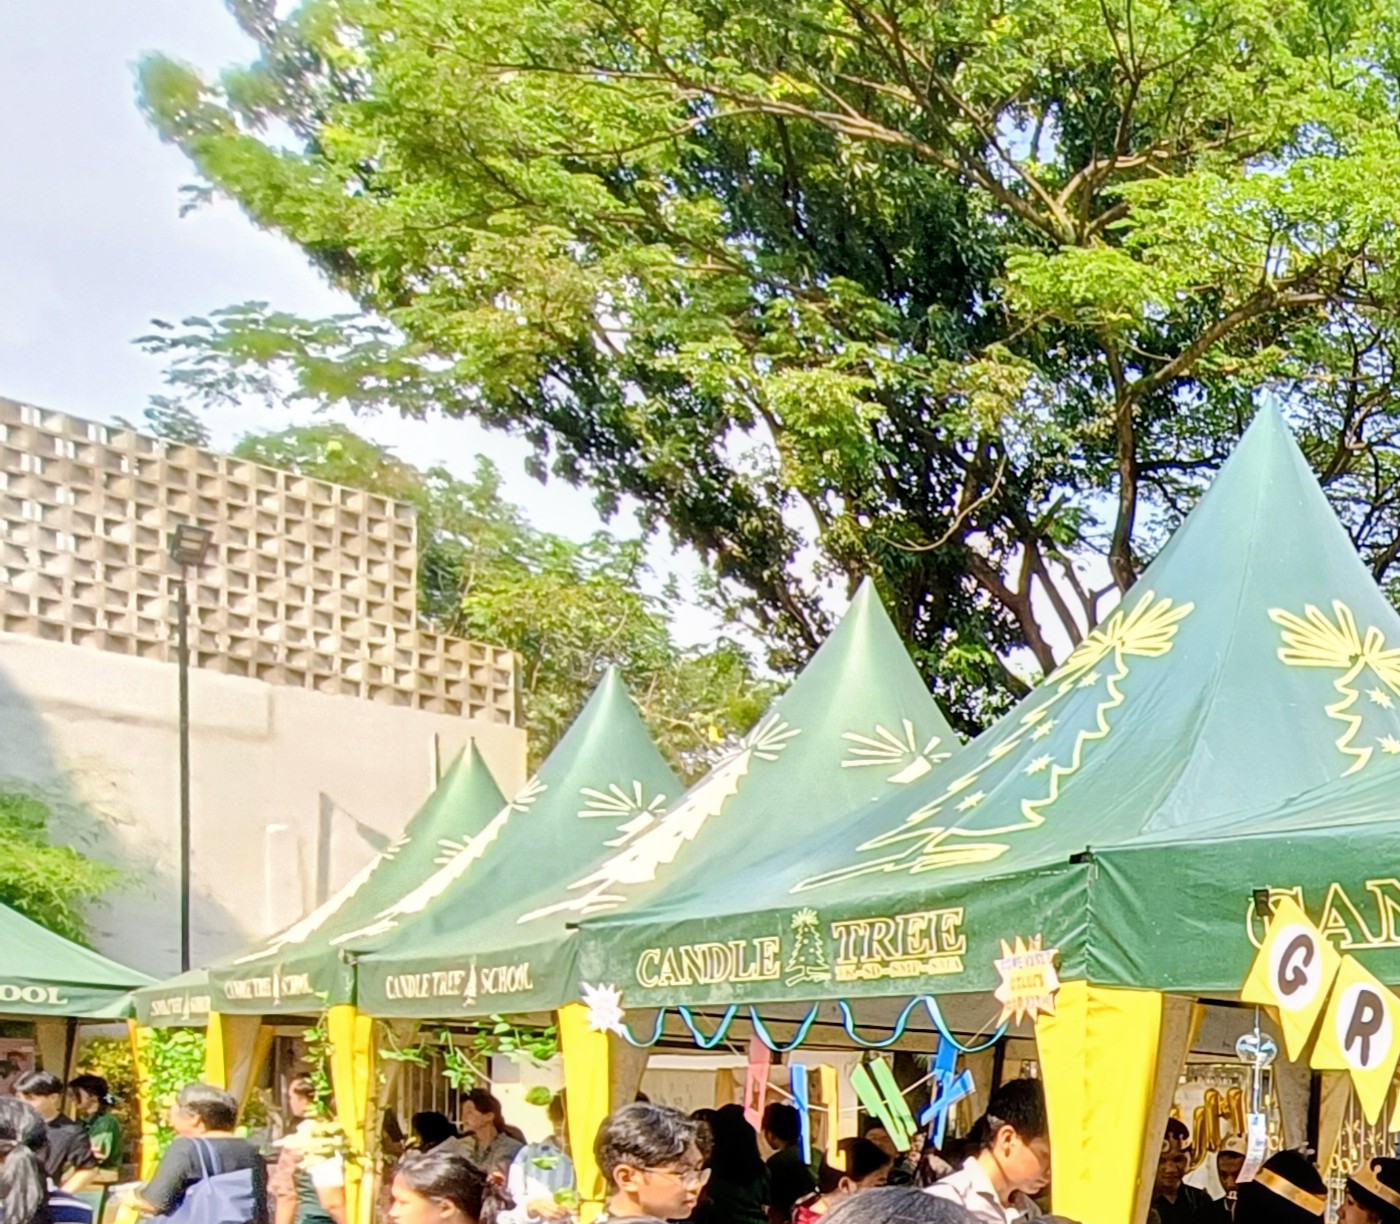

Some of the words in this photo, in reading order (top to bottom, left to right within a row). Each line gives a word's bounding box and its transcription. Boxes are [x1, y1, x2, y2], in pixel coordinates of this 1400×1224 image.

[636, 936, 781, 988] CANDLE
[831, 907, 966, 964] TREE
[385, 970, 430, 1000] CANDLE
[430, 970, 465, 997] TREE
[480, 962, 533, 994] SCHOOL
